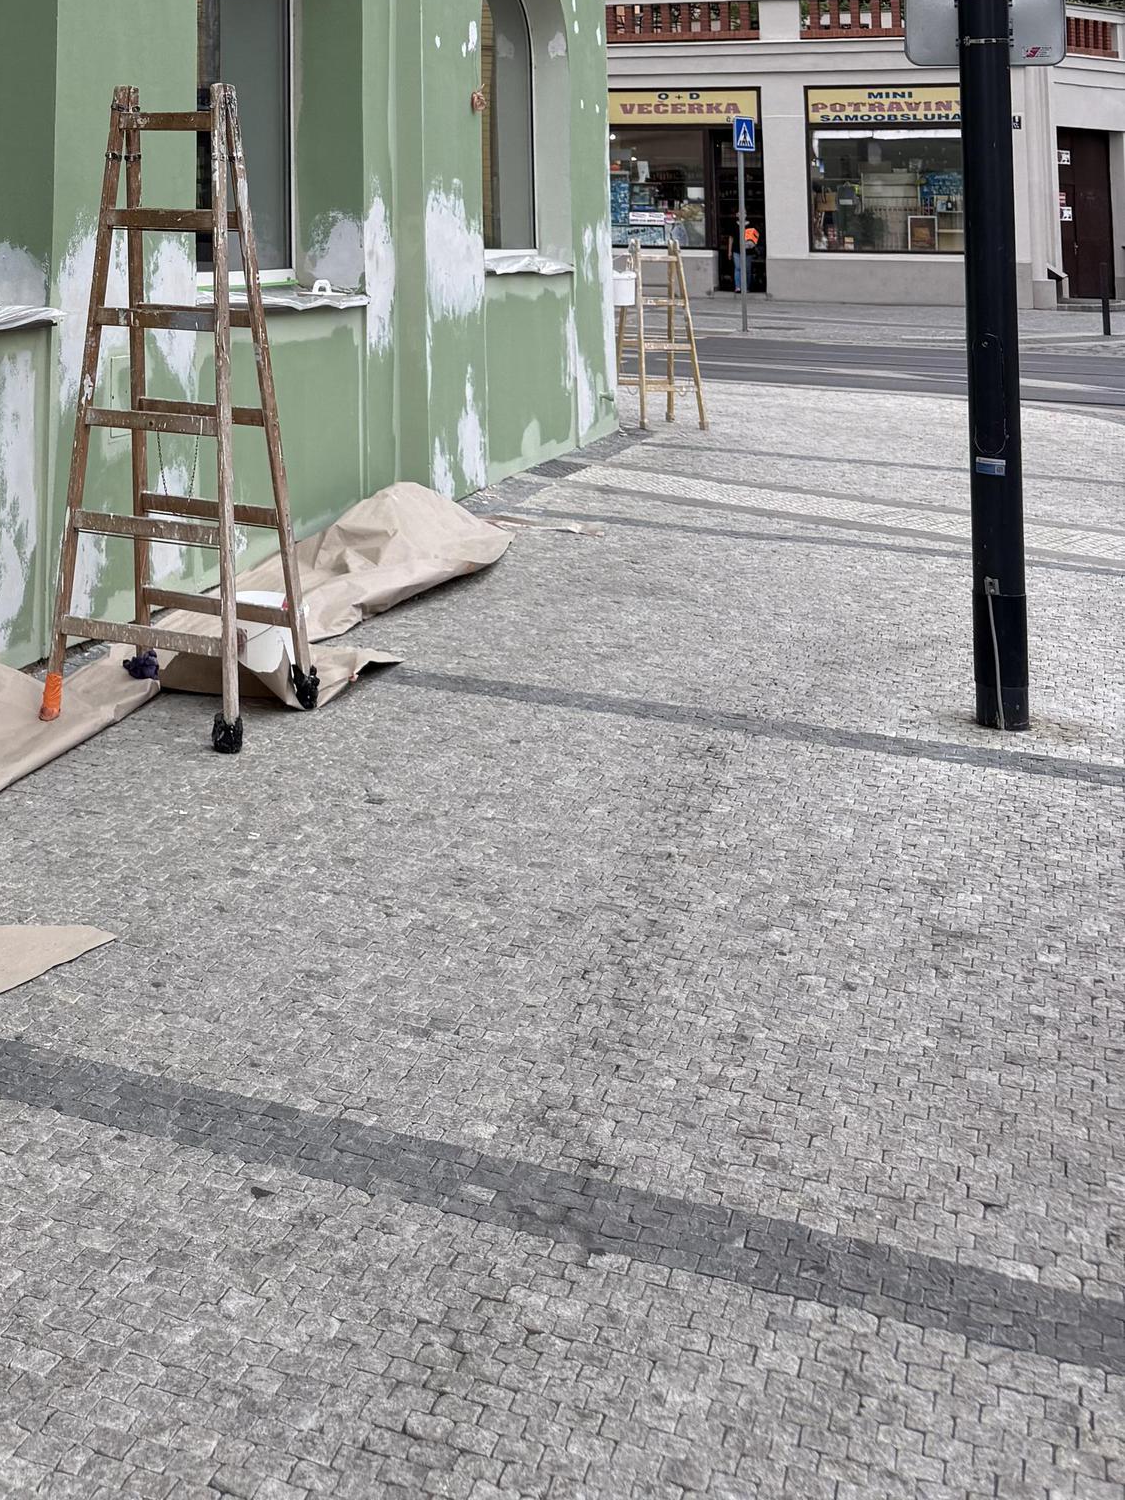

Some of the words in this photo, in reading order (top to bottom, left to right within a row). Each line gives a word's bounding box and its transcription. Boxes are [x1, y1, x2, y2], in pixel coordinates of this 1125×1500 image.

[657, 92, 670, 100] O
[689, 92, 700, 100] D
[620, 101, 741, 115] VEČERKA
[820, 113, 961, 122] SAMOOBSLUHA
